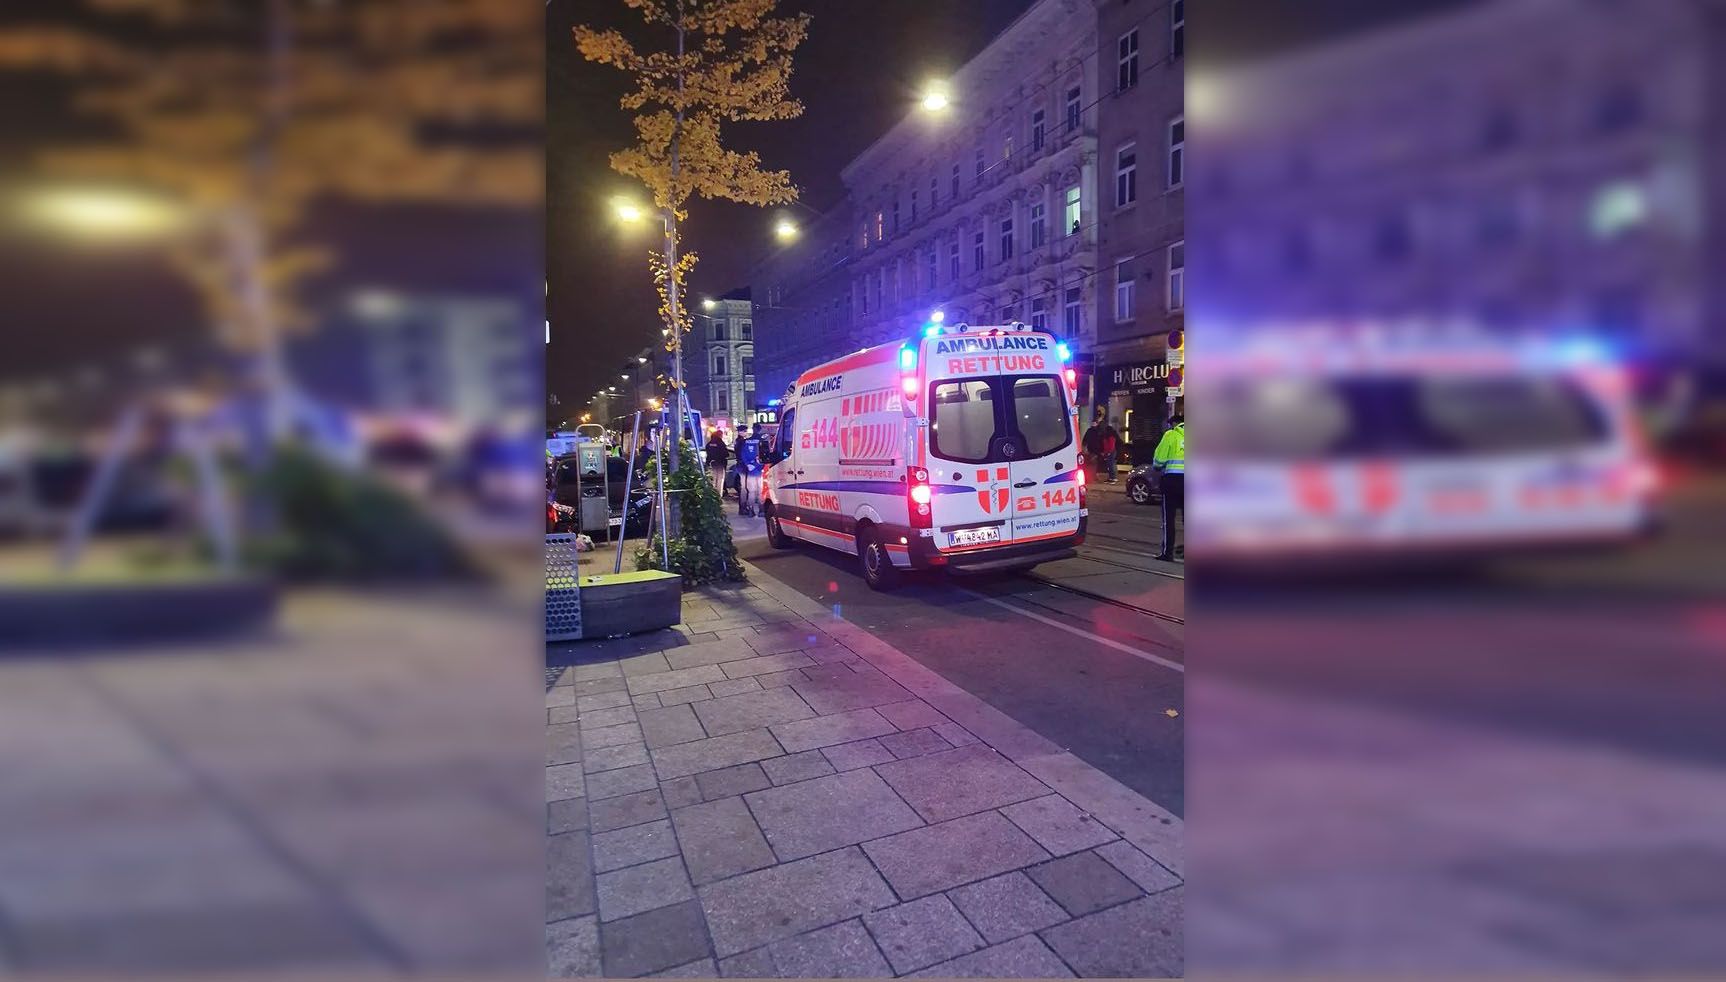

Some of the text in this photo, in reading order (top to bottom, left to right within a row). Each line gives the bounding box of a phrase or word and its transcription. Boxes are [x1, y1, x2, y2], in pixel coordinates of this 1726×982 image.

[936, 336, 1048, 354] AMBULANCE
[948, 355, 1045, 374] RETTUNG
[800, 375, 842, 398] AMBULANCE
[812, 416, 839, 449] 144
[799, 491, 840, 512] RETTUNG
[1042, 487, 1076, 508] 144
